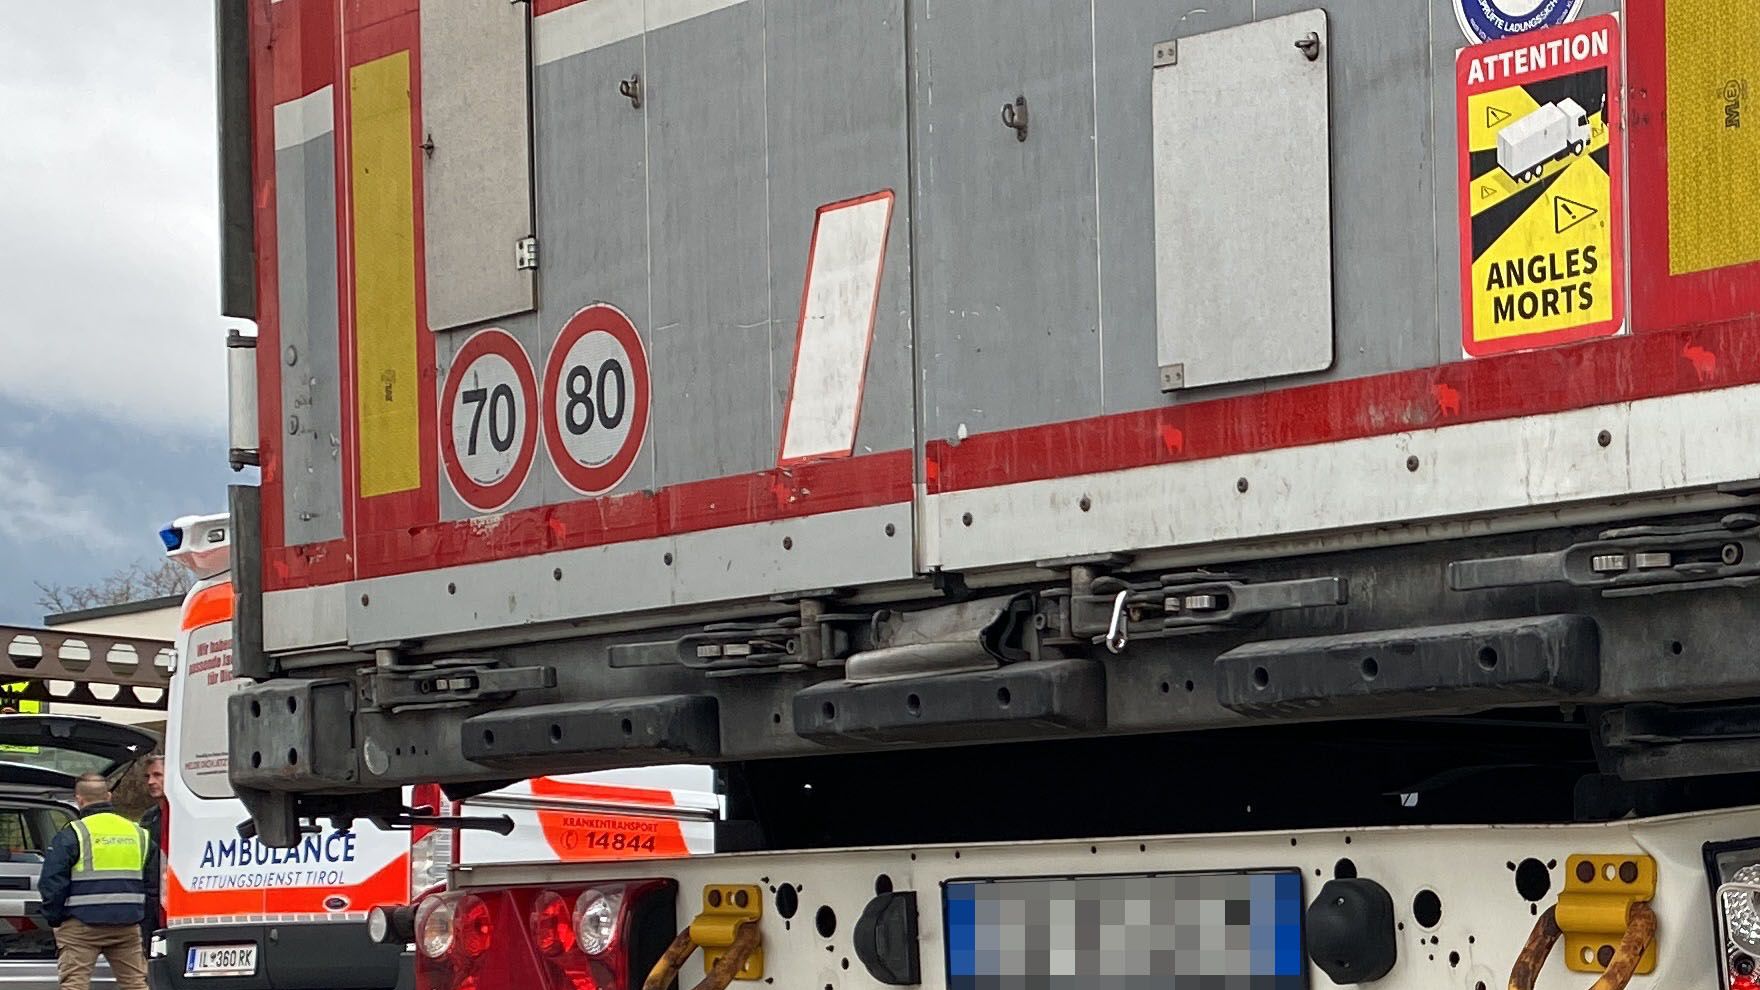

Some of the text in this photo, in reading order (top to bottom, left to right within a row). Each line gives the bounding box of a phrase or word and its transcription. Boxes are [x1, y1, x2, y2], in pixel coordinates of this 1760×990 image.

[1478, 0, 1505, 29] EPRÜFTE
[1503, 0, 1558, 33] LADUNGSSICH
[1467, 28, 1609, 86] ATTENTION
[1486, 245, 1598, 292] ANGLES
[1493, 281, 1593, 324] MORTS
[565, 358, 626, 435] 80
[462, 383, 516, 456] 70
[562, 817, 659, 832] KRANKENTRANSPORT
[586, 831, 656, 852] 14844
[200, 832, 356, 868] AMBULANCE
[191, 870, 345, 889] RETTUNGSDIENST TIROL
[216, 949, 237, 967] 360
[238, 949, 253, 966] RK
